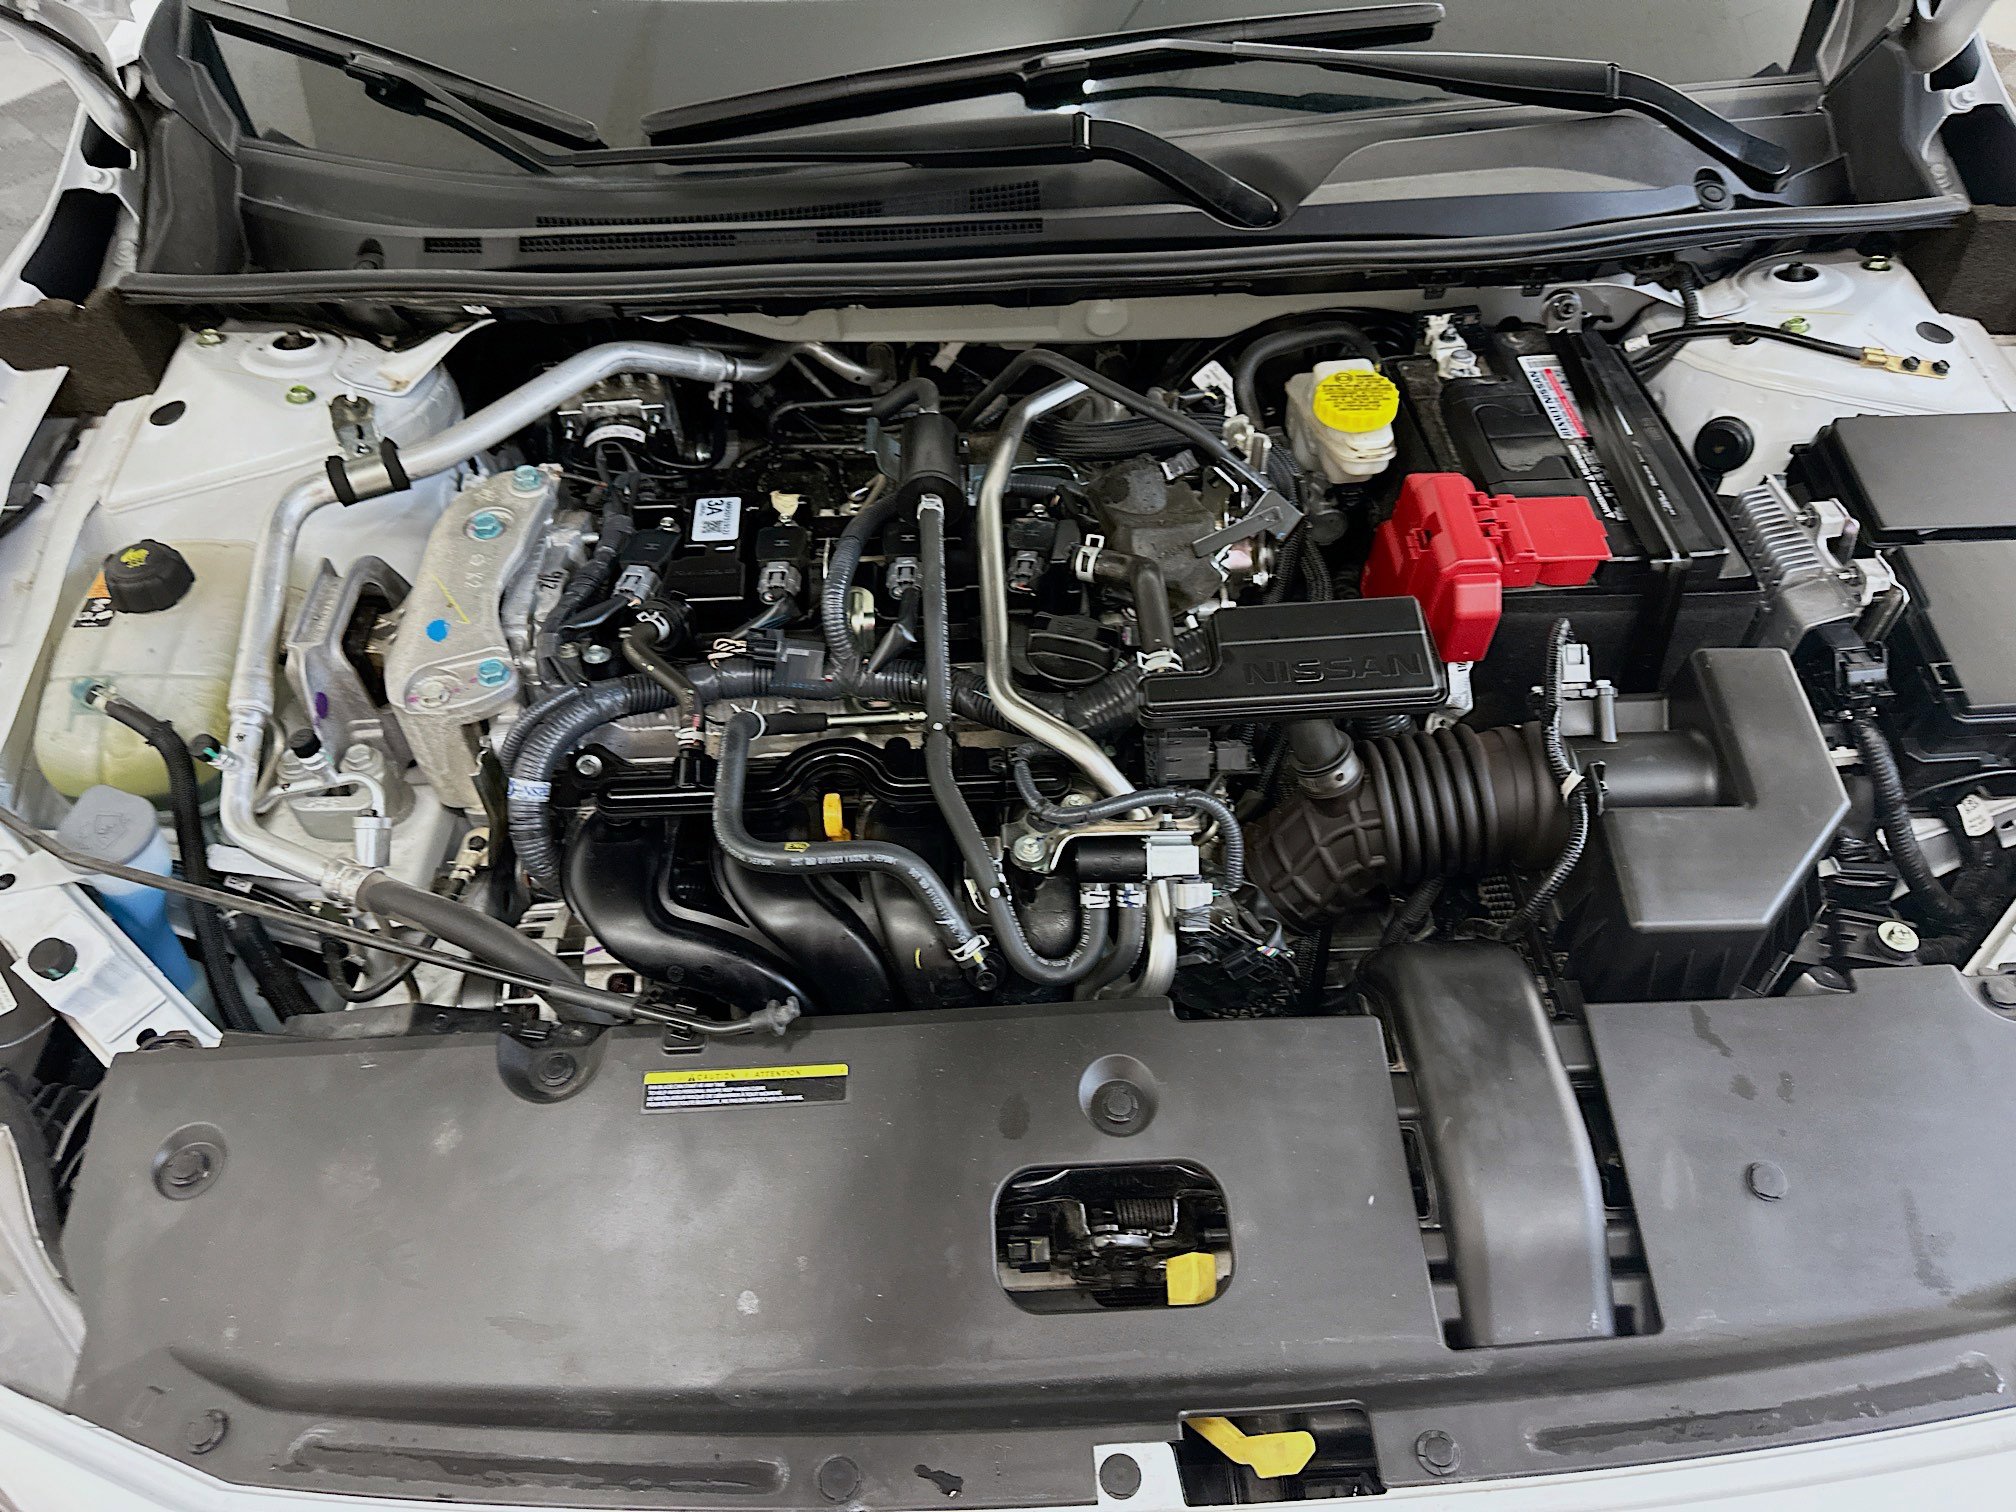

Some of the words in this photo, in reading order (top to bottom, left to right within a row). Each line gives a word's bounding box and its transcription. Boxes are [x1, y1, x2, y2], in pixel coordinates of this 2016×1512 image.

[1529, 370, 1551, 404] NISSAN
[706, 500, 725, 516] 3A
[1246, 653, 1425, 685] NISSAN
[696, 1073, 736, 1082] CAUTION
[754, 1069, 802, 1079] ATTENTION
